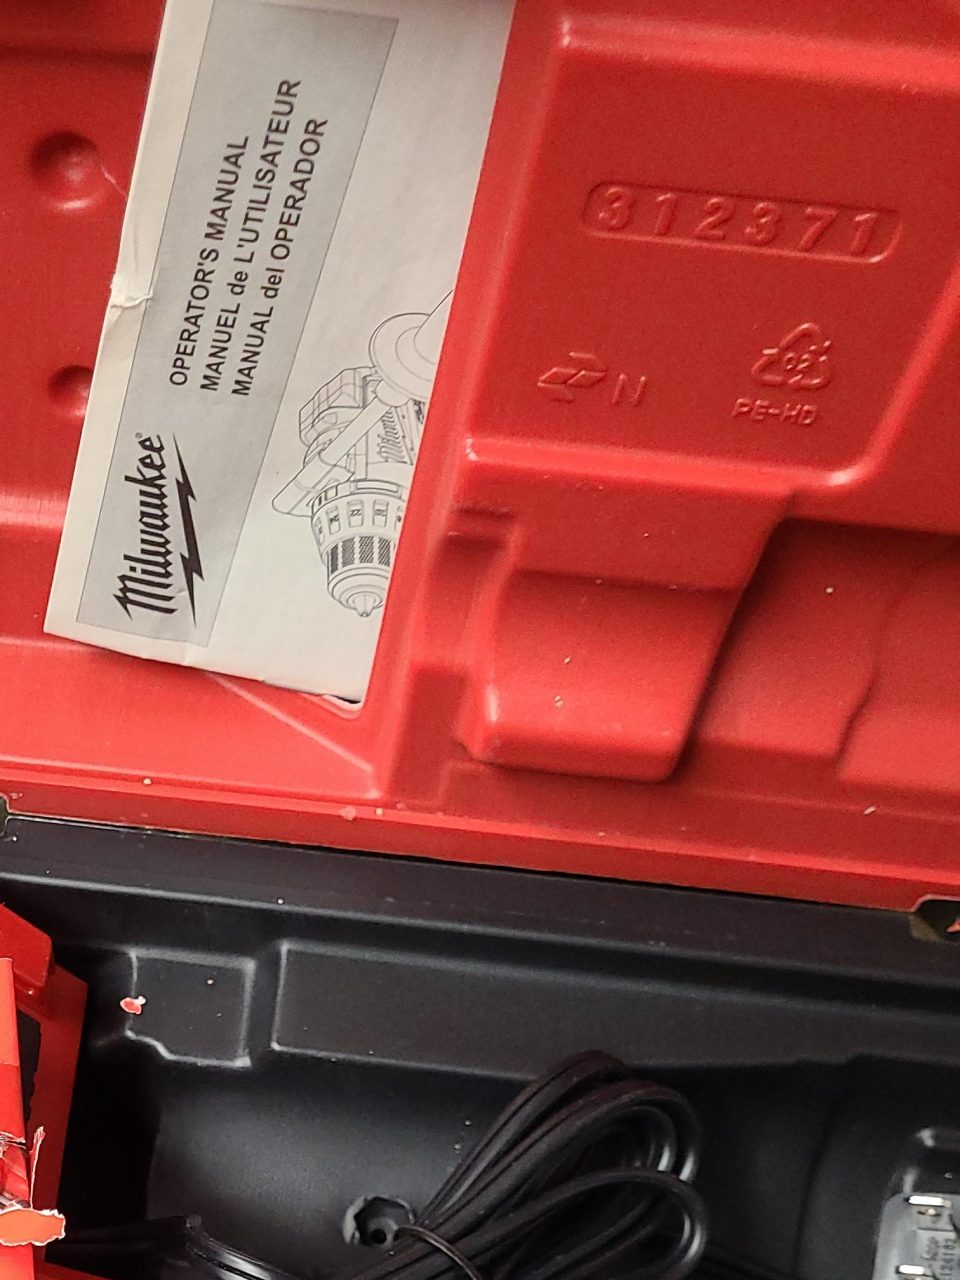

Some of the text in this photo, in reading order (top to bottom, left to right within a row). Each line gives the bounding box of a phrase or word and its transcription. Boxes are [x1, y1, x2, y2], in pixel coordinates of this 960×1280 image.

[169, 136, 248, 385] OPERATOR'S MANUAL
[200, 80, 300, 391] MANUEL de L'UTILISATEUR
[231, 119, 328, 395] MANUAL del OPERADOR
[597, 185, 878, 257] 312371
[732, 397, 818, 426] PE-HD
